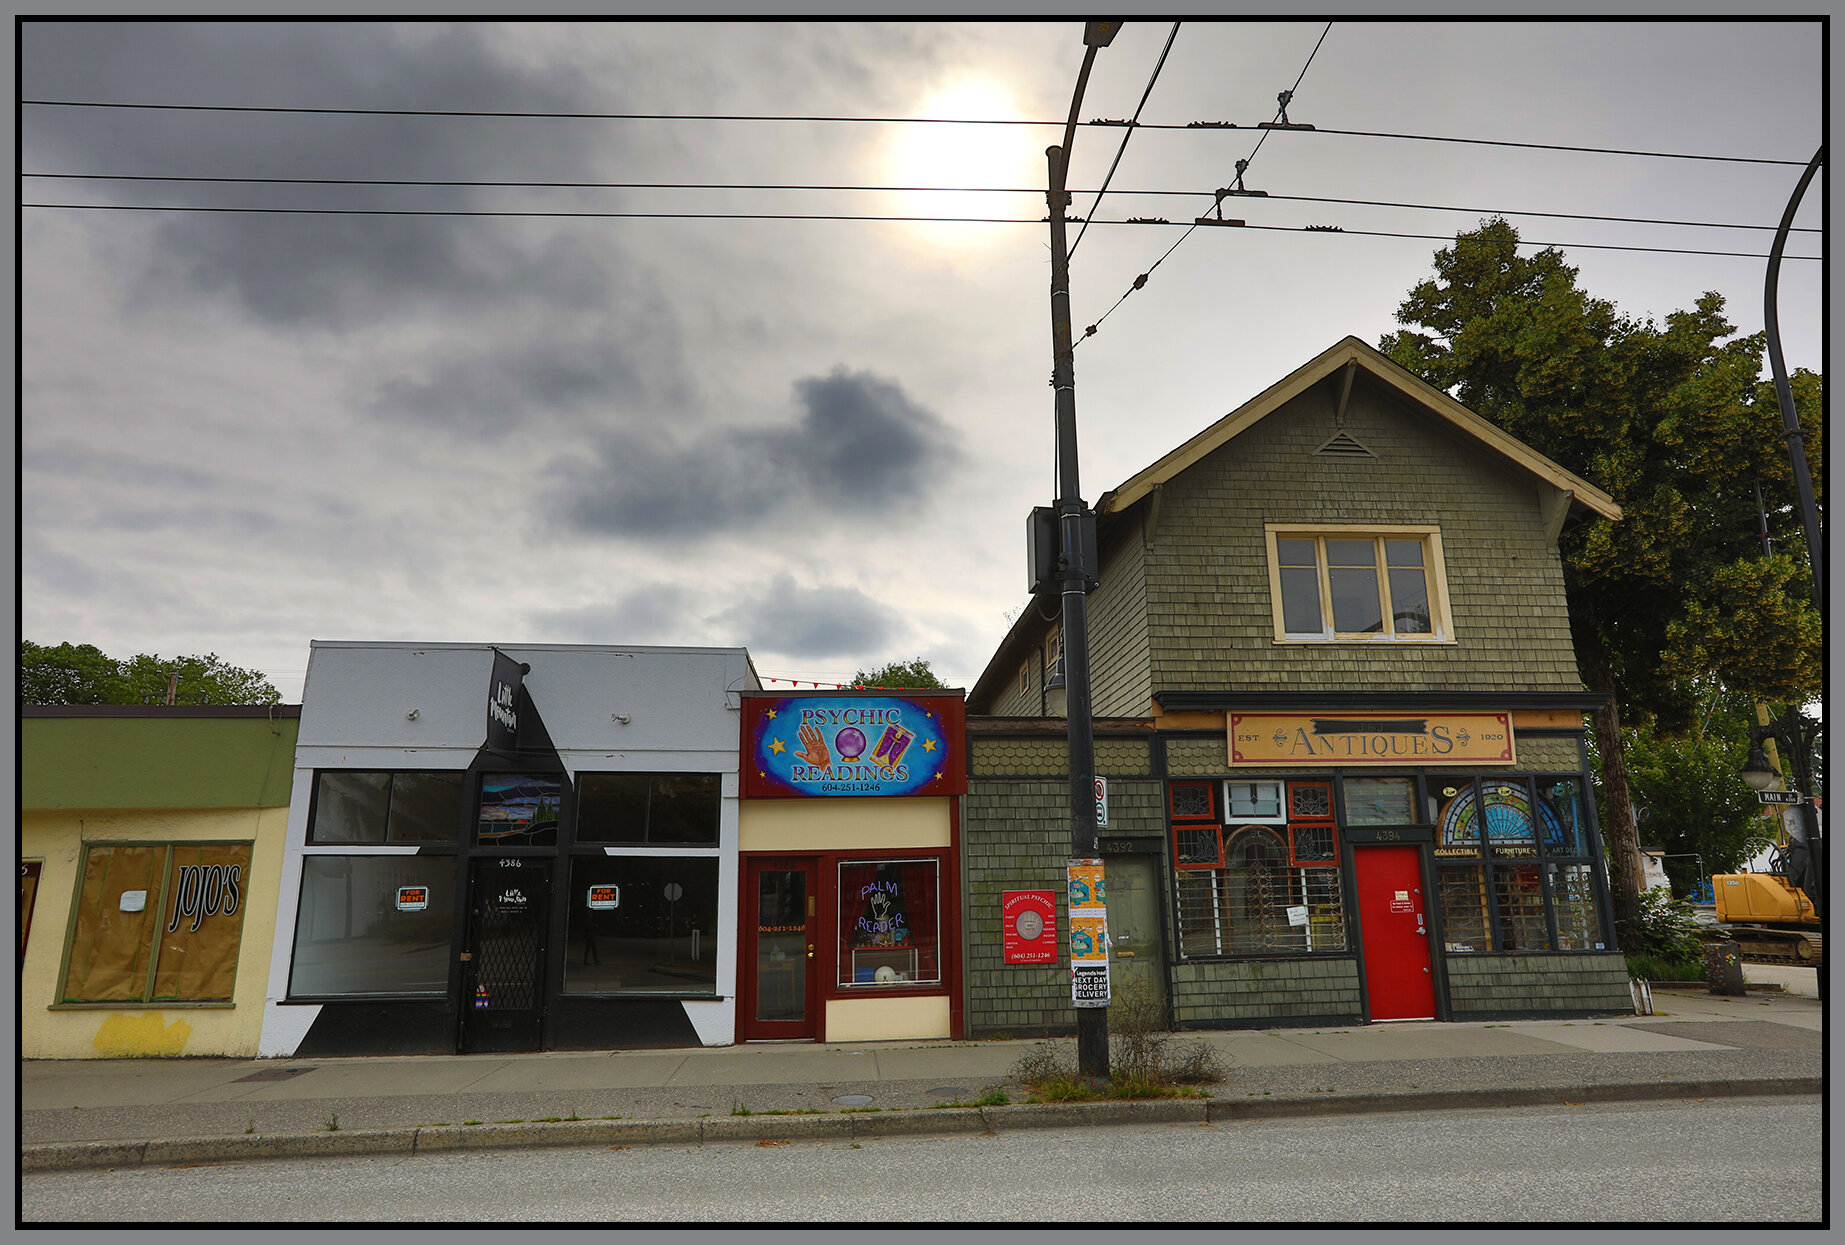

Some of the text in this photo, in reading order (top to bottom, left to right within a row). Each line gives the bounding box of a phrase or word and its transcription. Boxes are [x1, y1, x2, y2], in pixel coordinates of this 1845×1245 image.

[801, 708, 901, 726] PSYCHIC
[1289, 725, 1454, 757] ANTIQUES
[1480, 733, 1504, 741] 1920
[791, 764, 909, 782] READINGS
[821, 783, 881, 792] 604-251-1246
[1764, 792, 1782, 802] MAIN
[1376, 830, 1401, 841] 4394
[1106, 842, 1133, 853] 4392
[1435, 848, 1479, 856] COLLECTIBLE
[499, 858, 522, 868] 4386
[861, 880, 898, 900] PALM
[167, 863, 242, 933] JOJO'S
[400, 895, 425, 903] RENT
[591, 893, 616, 901] RENT
[1004, 894, 1054, 910] SPIRITUAL PSYCHIC
[858, 912, 904, 933] READER
[758, 924, 806, 933] 604-251-1246
[1026, 952, 1051, 960] 251-1246
